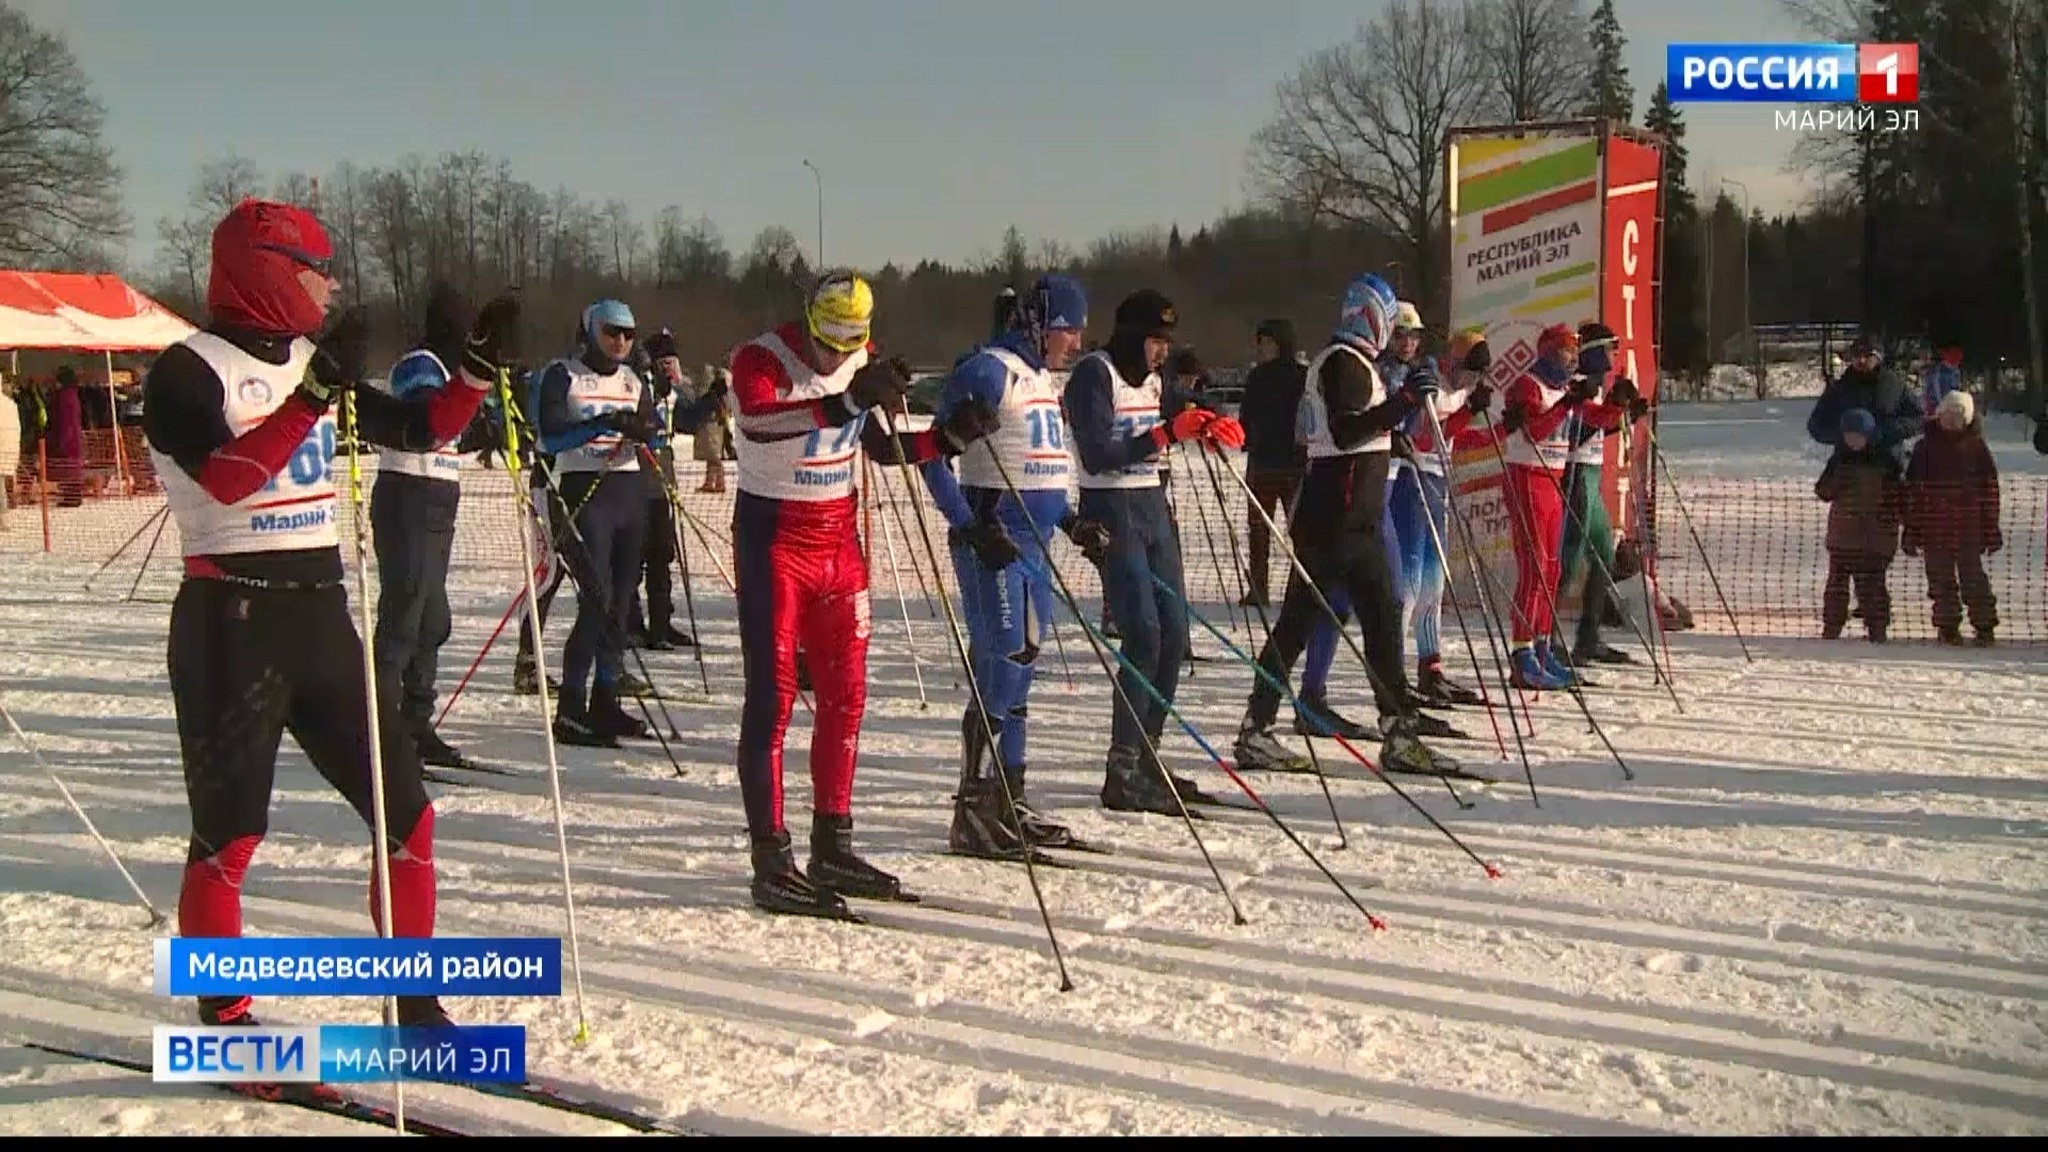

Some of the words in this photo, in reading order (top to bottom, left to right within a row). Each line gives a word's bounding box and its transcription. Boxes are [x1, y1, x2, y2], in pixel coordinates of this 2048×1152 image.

[1467, 221, 1582, 268] РЕСПУБЛИКА
[1476, 249, 1542, 284] МАРИЙ
[1546, 243, 1571, 263] ЭЛ
